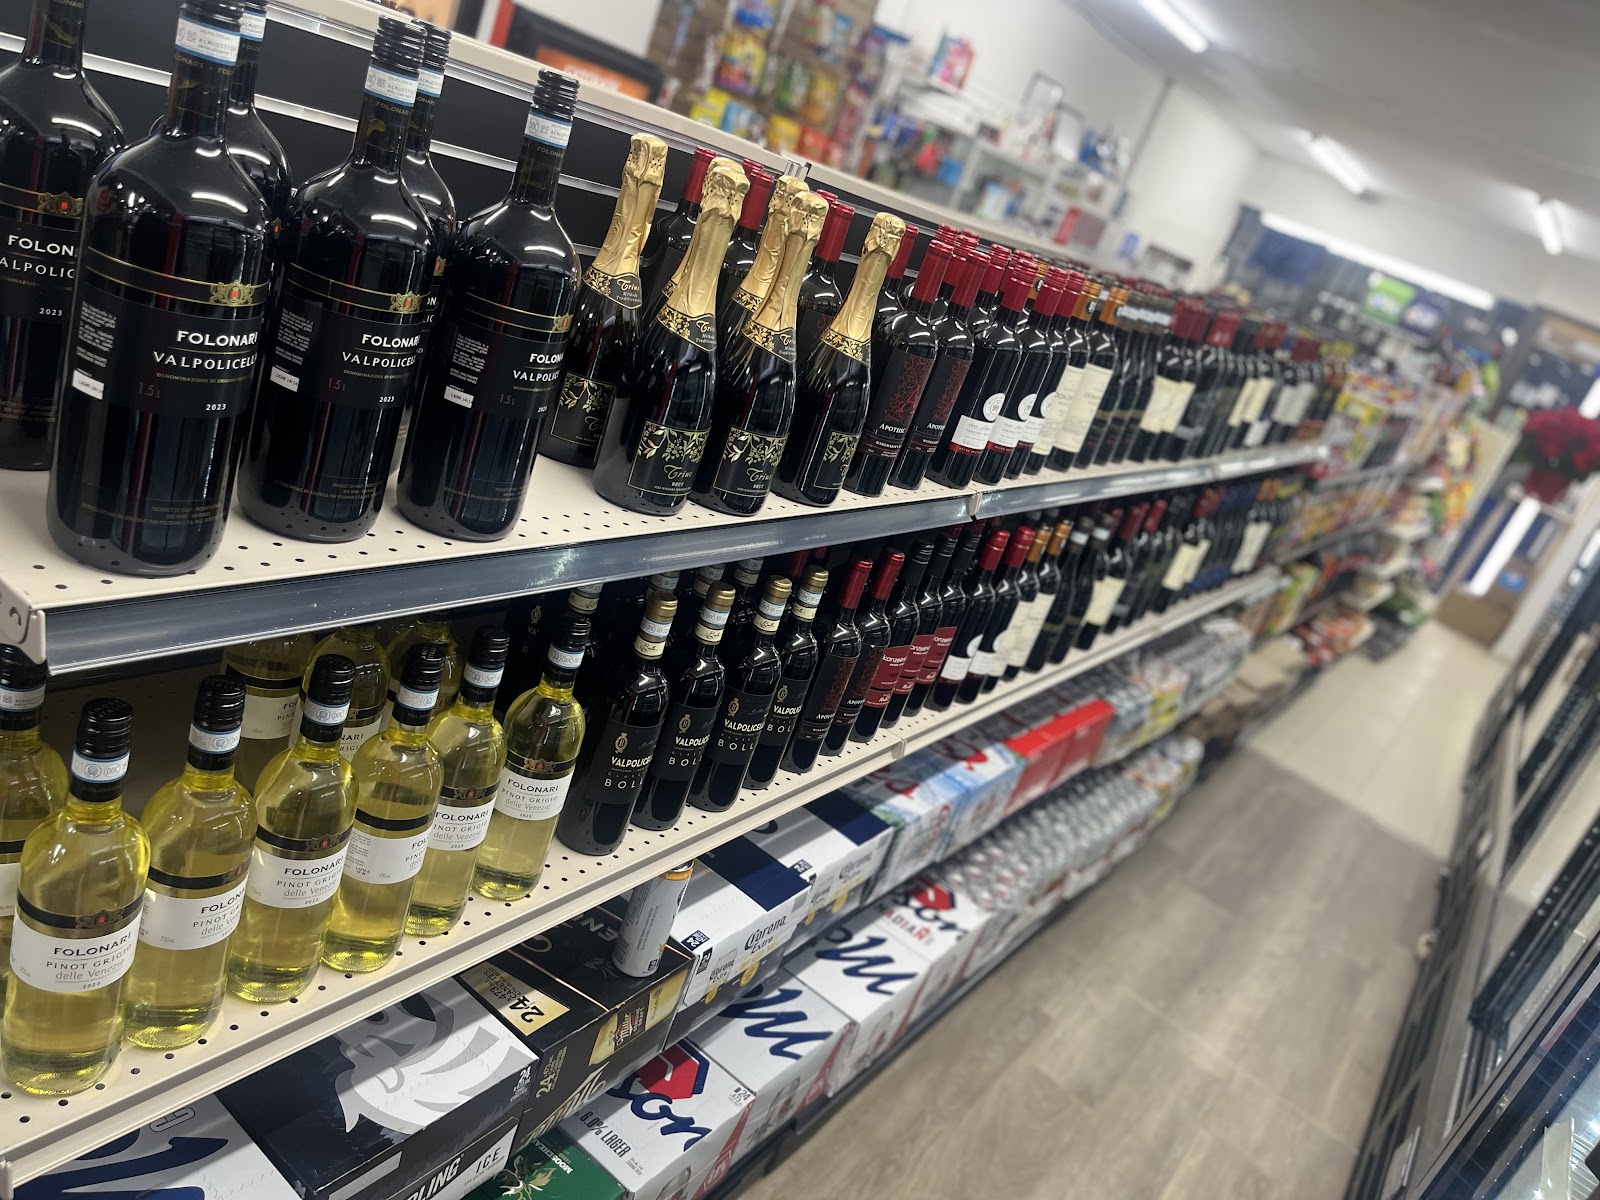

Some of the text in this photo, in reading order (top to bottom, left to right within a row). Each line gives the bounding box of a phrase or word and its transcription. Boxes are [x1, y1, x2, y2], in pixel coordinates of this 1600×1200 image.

[8, 235, 78, 258] FOLON
[39, 307, 63, 317] 2023
[205, 403, 227, 412] 2023
[767, 723, 791, 733] BOL
[508, 778, 559, 793] FOLONARI
[502, 788, 558, 803] PINOT GRIGIO
[505, 797, 550, 811] delle Venezie
[435, 809, 489, 821] FOLONARI
[433, 830, 482, 840] delle Venezie
[434, 824, 457, 832] INOT
[276, 880, 311, 888] PINOT
[284, 889, 307, 897] delle
[193, 914, 228, 928] PINOT
[201, 924, 224, 936] delle
[744, 916, 786, 951] Corona
[54, 931, 132, 957] FOLONARI
[751, 937, 773, 954] Extra
[46, 943, 132, 970] PINOT GRIGIO
[55, 958, 124, 980] delle Venezie
[83, 981, 101, 989] 2023
[483, 969, 517, 999] CANETTES
[509, 995, 545, 1023] 24
[519, 1066, 531, 1081] 24
[536, 1073, 555, 1098] 24
[738, 1089, 751, 1101] 24
[580, 1110, 608, 1136] 6.0%
[600, 1130, 631, 1158] LAGER
[476, 1147, 501, 1174] ICE
